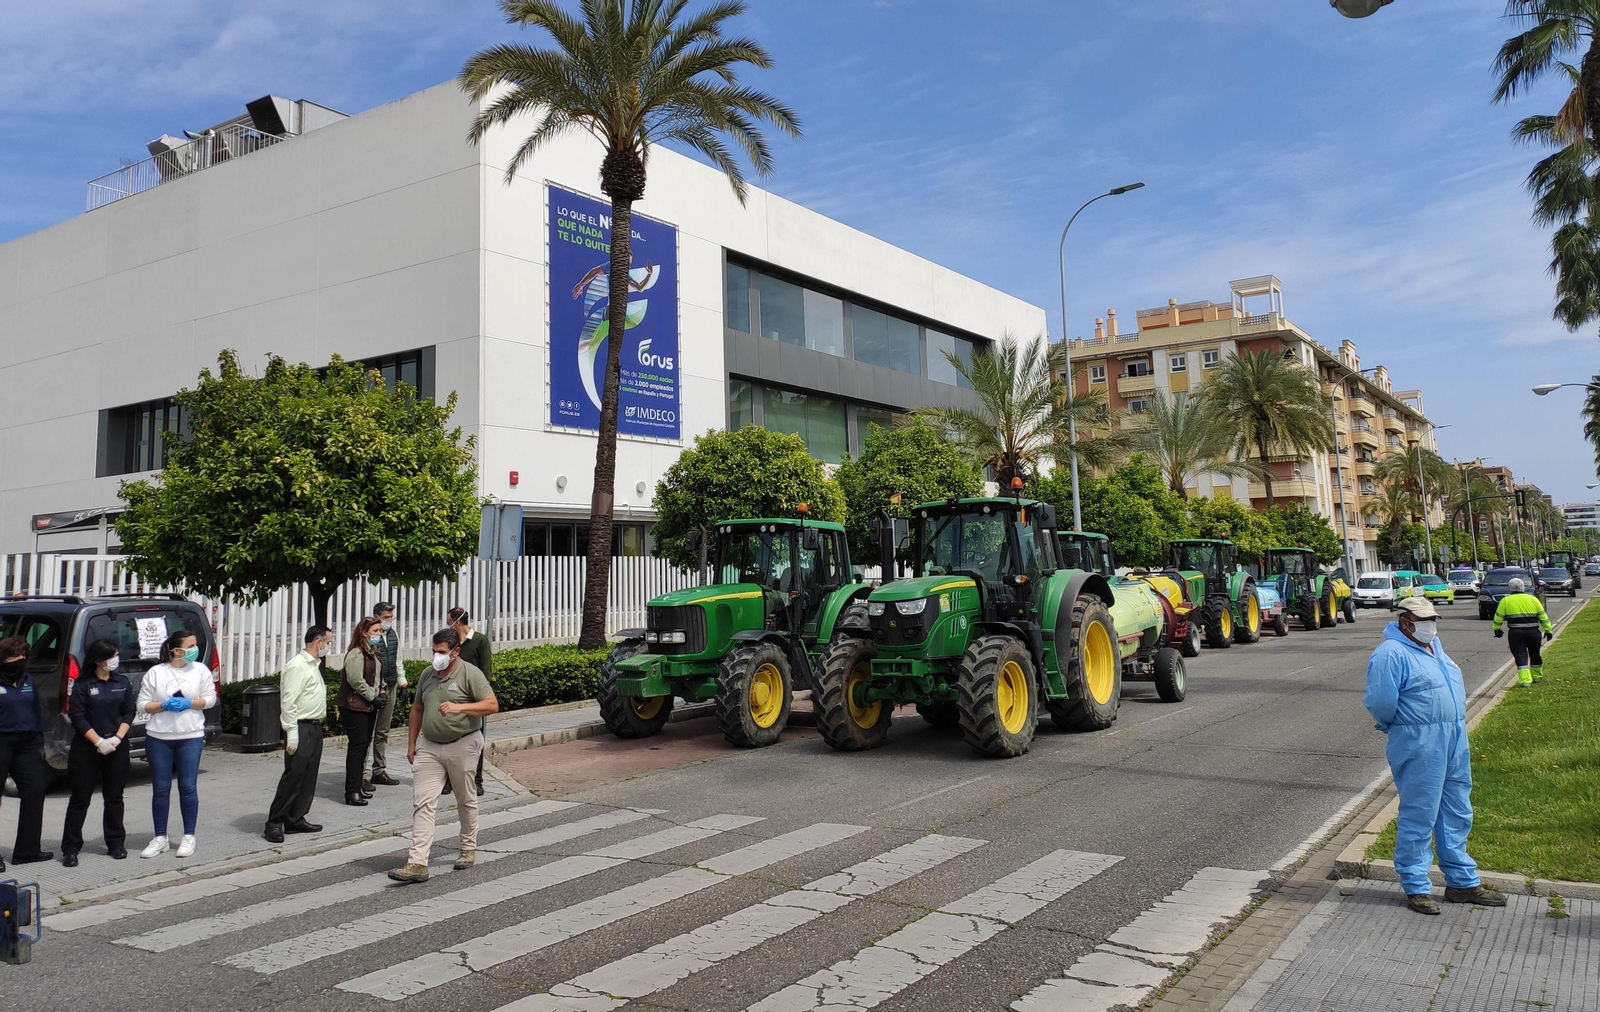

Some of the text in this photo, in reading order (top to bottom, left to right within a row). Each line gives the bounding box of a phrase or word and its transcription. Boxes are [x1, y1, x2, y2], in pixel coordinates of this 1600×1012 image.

[557, 205, 569, 217] LO
[570, 210, 587, 223] QUE
[588, 215, 598, 226] EL
[557, 217, 604, 240] QUE NADA
[557, 229, 611, 254] TE LO QUITE
[635, 380, 649, 388] 2.000
[650, 383, 674, 392] empleados
[637, 406, 676, 423] IMDECO
